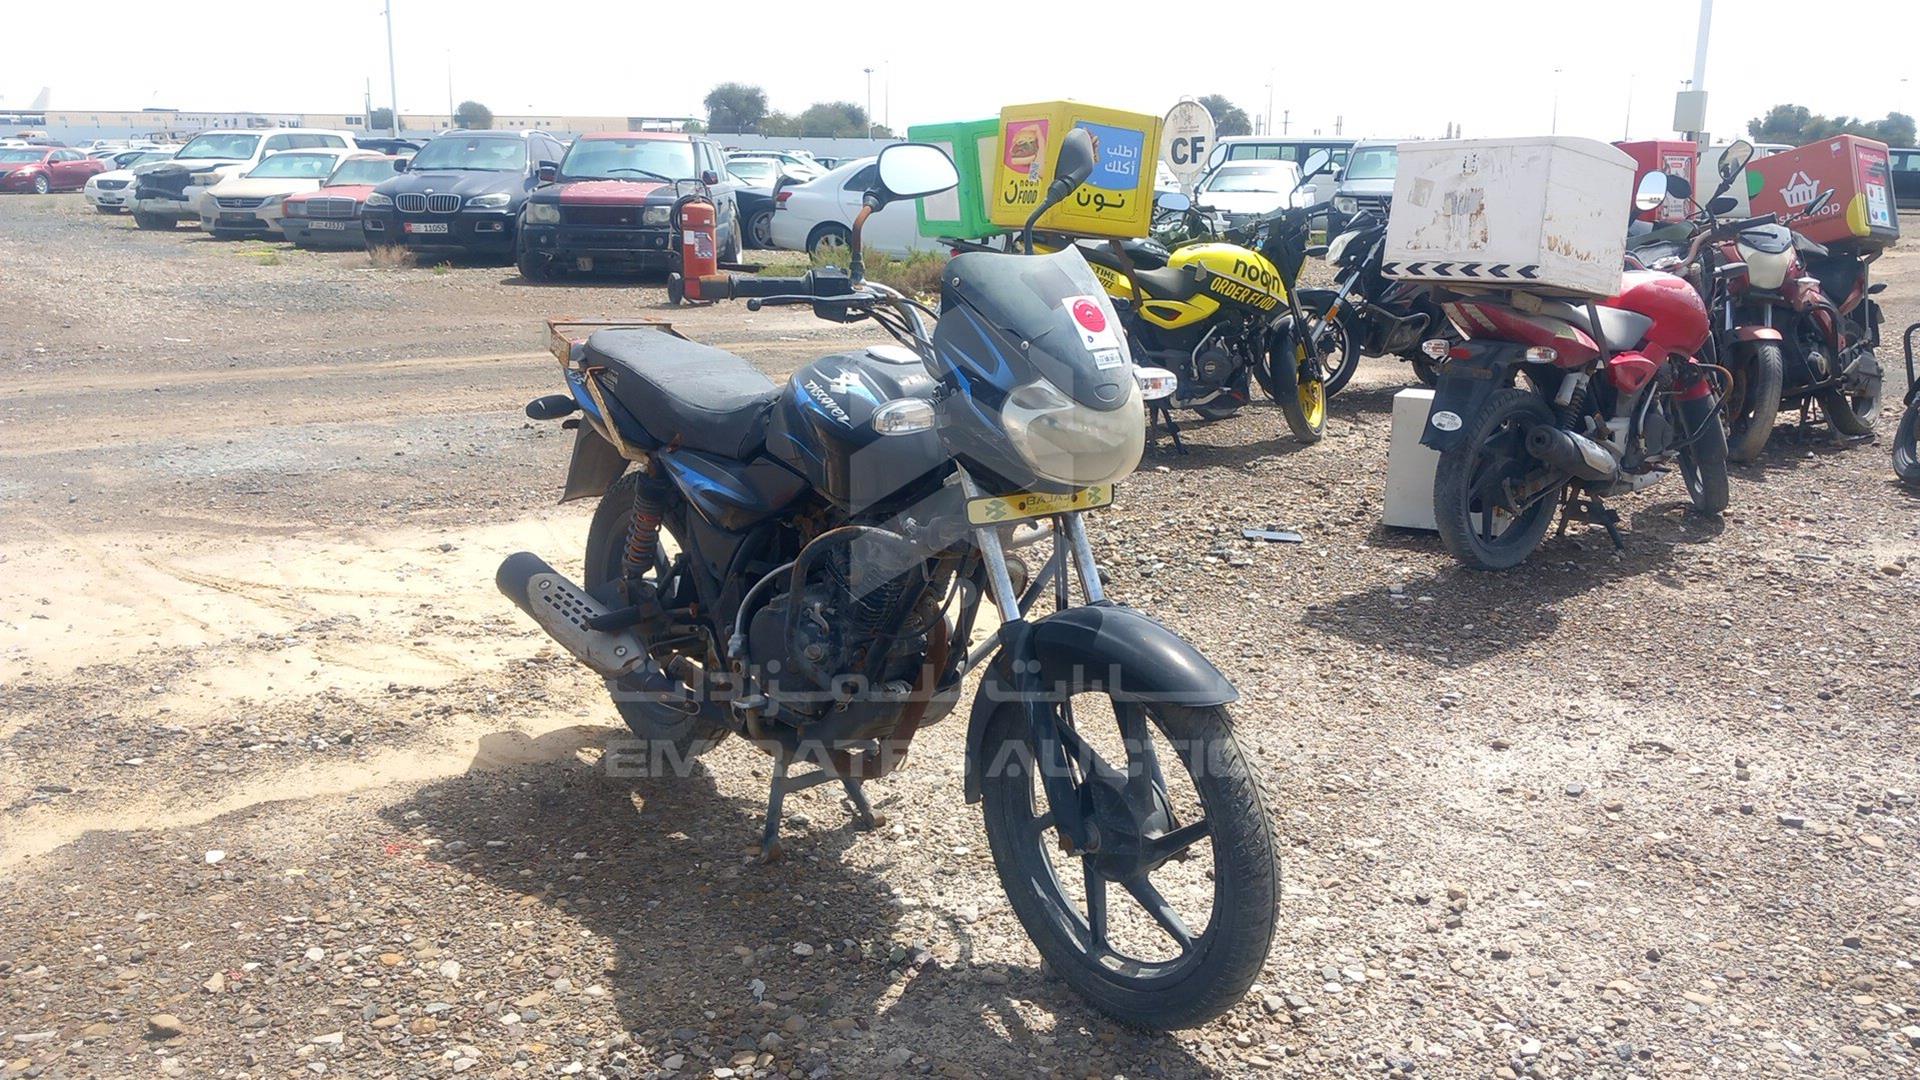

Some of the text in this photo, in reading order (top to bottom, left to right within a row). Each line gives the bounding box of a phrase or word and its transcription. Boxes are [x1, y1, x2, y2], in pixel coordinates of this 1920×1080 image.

[1106, 144, 1138, 159] اطلب
[1171, 136, 1205, 165] CF
[1104, 160, 1136, 176] أكلك
[1017, 189, 1038, 205] FOOD
[1076, 187, 1126, 212] نون
[1233, 258, 1281, 294] noon
[1209, 276, 1279, 312] ORDER FOOD
